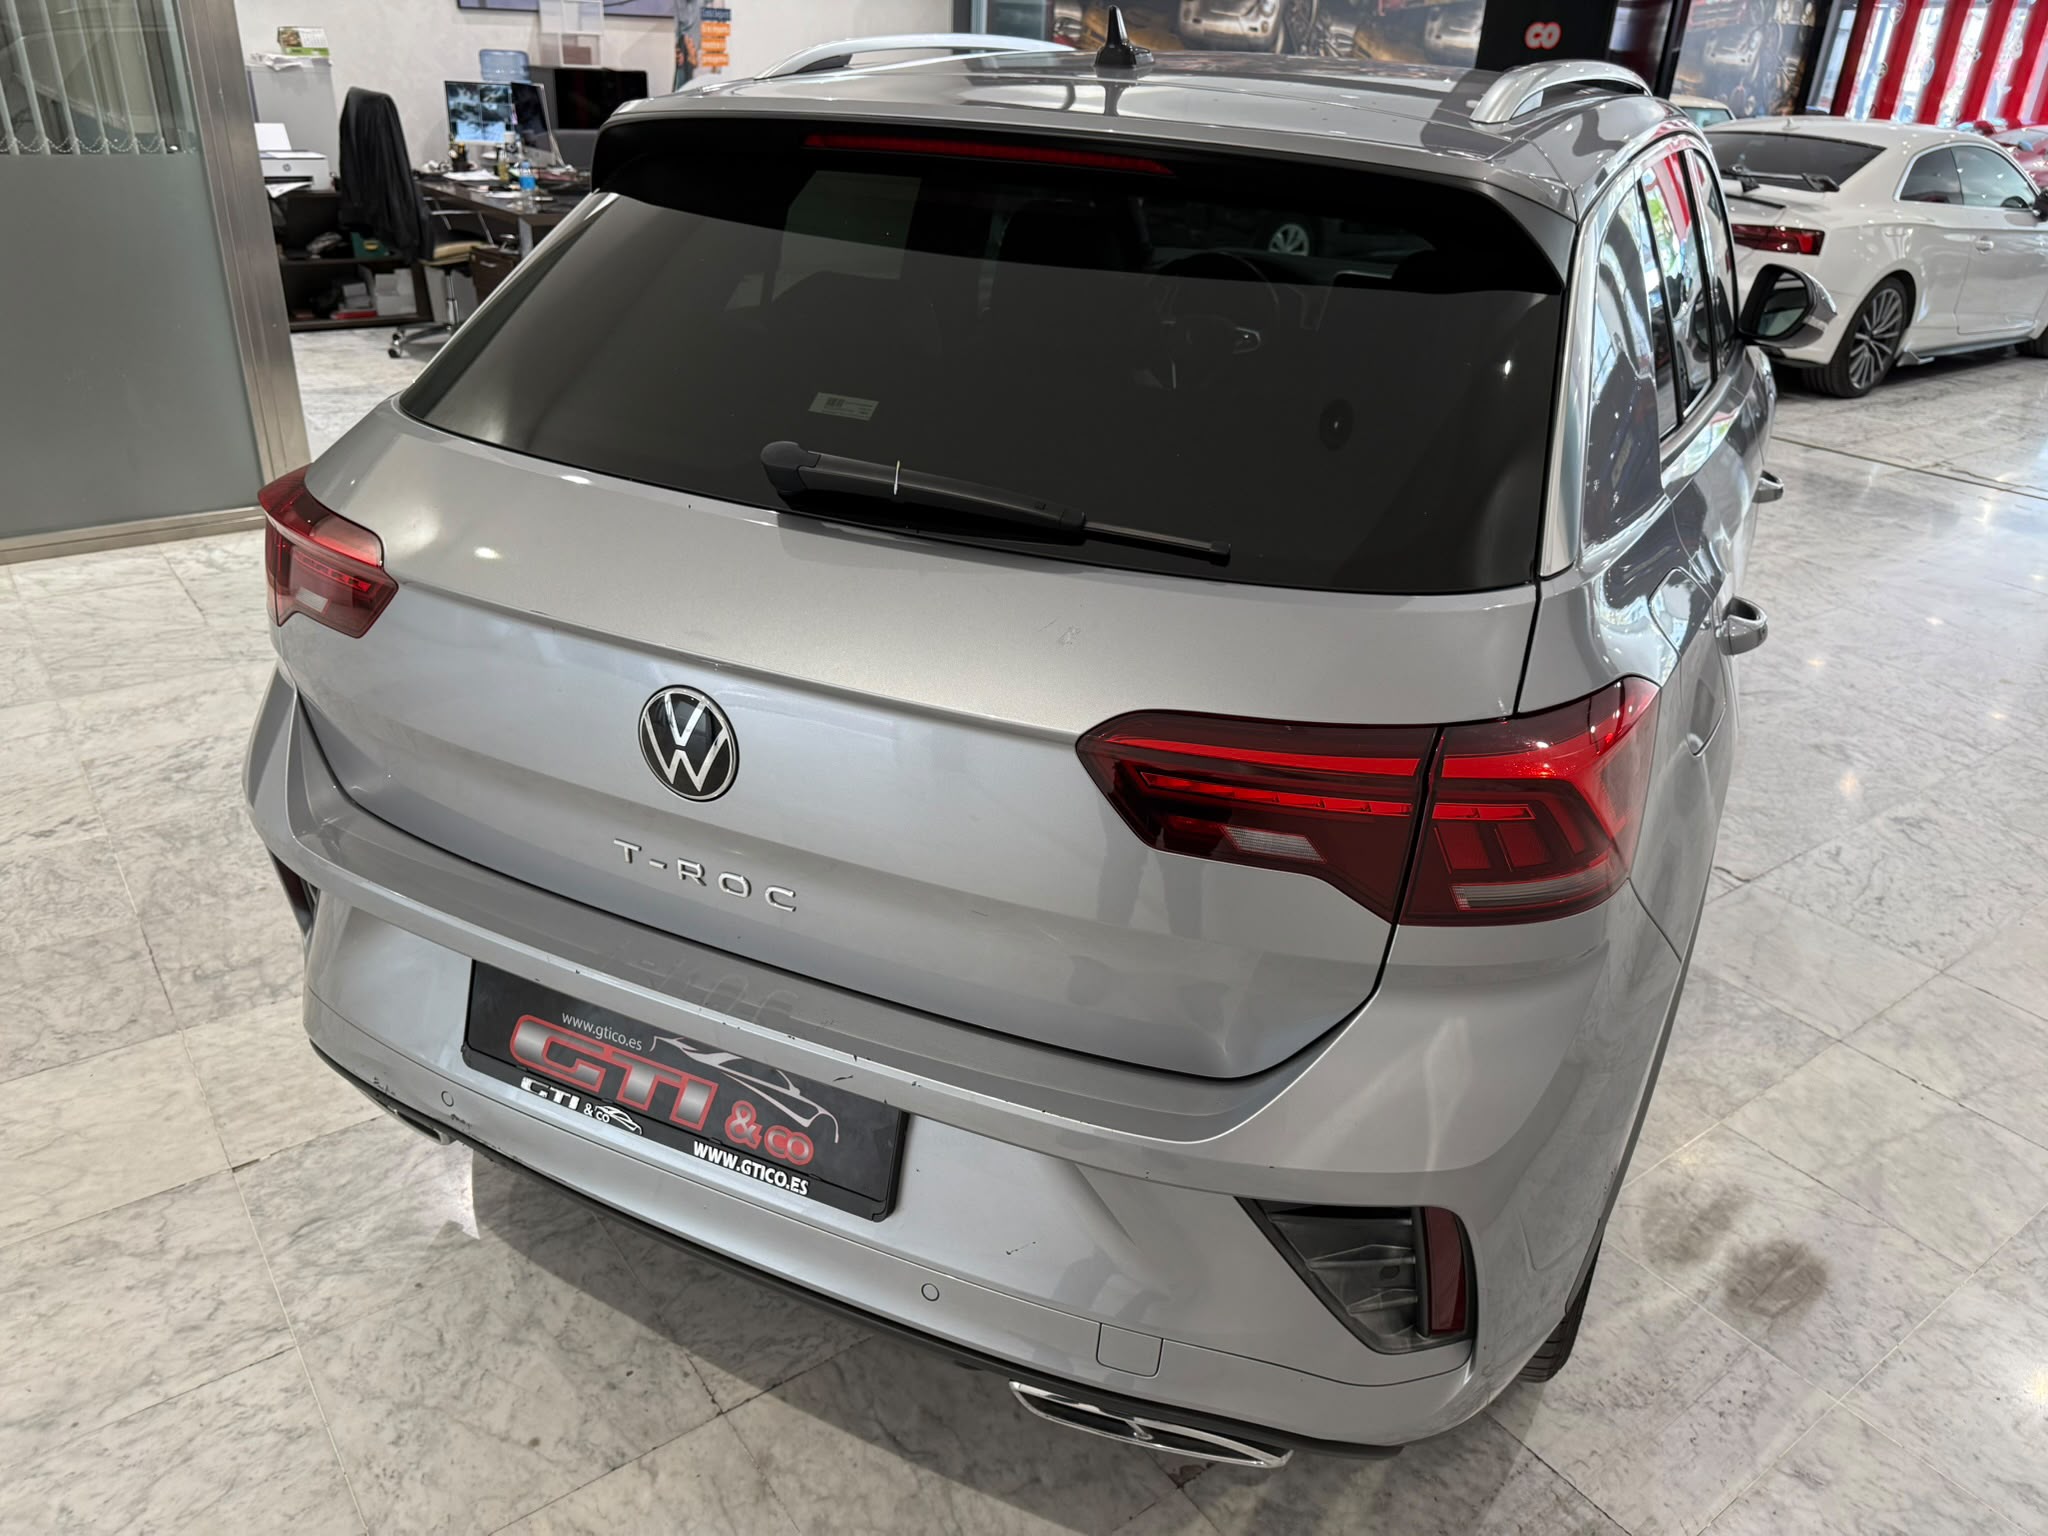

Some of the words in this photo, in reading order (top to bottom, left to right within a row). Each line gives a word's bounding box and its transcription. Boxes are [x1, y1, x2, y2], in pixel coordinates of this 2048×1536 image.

[613, 837, 797, 912] T-ROC
[561, 1011, 643, 1051] www.gtico.es
[509, 1014, 719, 1131] GTI
[520, 1076, 580, 1111] GTI
[693, 1140, 809, 1196] WWW.GTICO.ES
